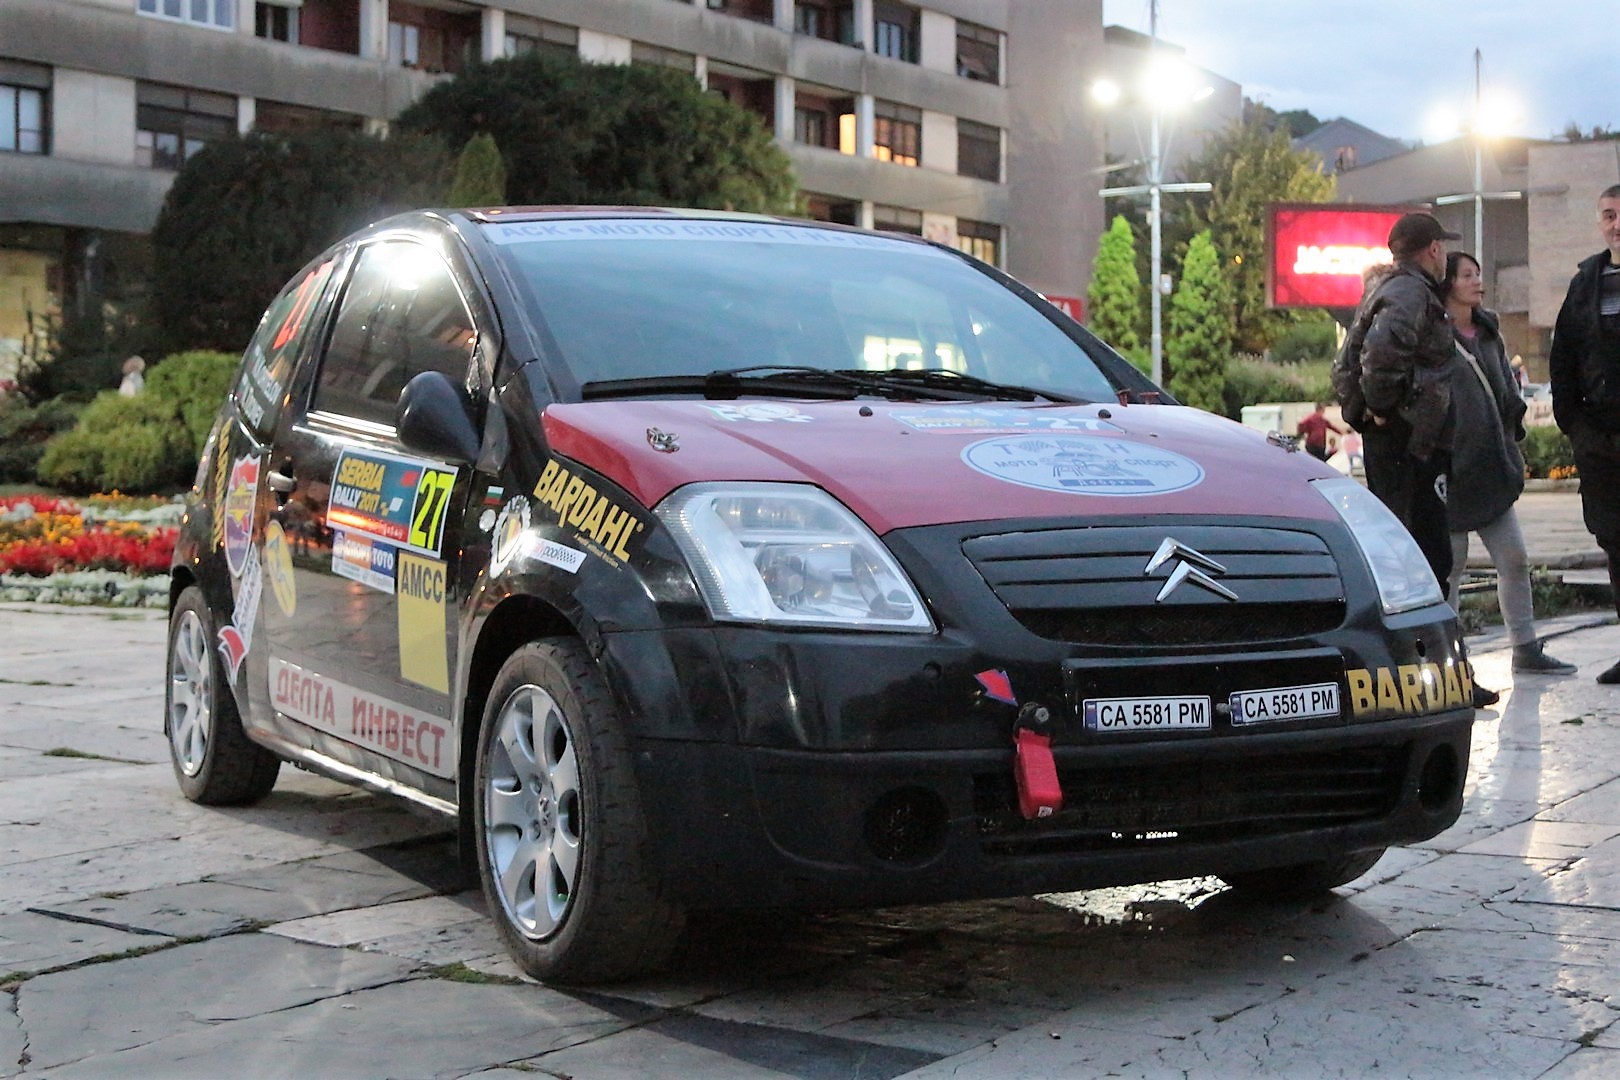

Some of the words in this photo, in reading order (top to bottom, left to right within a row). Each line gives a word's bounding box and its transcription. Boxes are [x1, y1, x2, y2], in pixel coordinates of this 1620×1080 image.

[585, 224, 676, 236] МОТО
[682, 225, 776, 239] СПОРТ
[1036, 417, 1103, 430] 27
[337, 456, 386, 492] SERBIA
[333, 485, 362, 508] RALLY
[358, 490, 381, 513] 2017
[409, 470, 455, 551] 27
[533, 458, 638, 563] BARDAHL
[400, 561, 443, 604] AMCC
[1245, 696, 1269, 719] CA
[1273, 693, 1306, 716] 5581
[1311, 689, 1334, 712] PM
[1347, 661, 1474, 717] BARDAH
[352, 695, 446, 769] ИНВЕСТ
[1100, 704, 1128, 727] CA
[1133, 703, 1172, 725] 5581
[1179, 702, 1204, 724] PM
